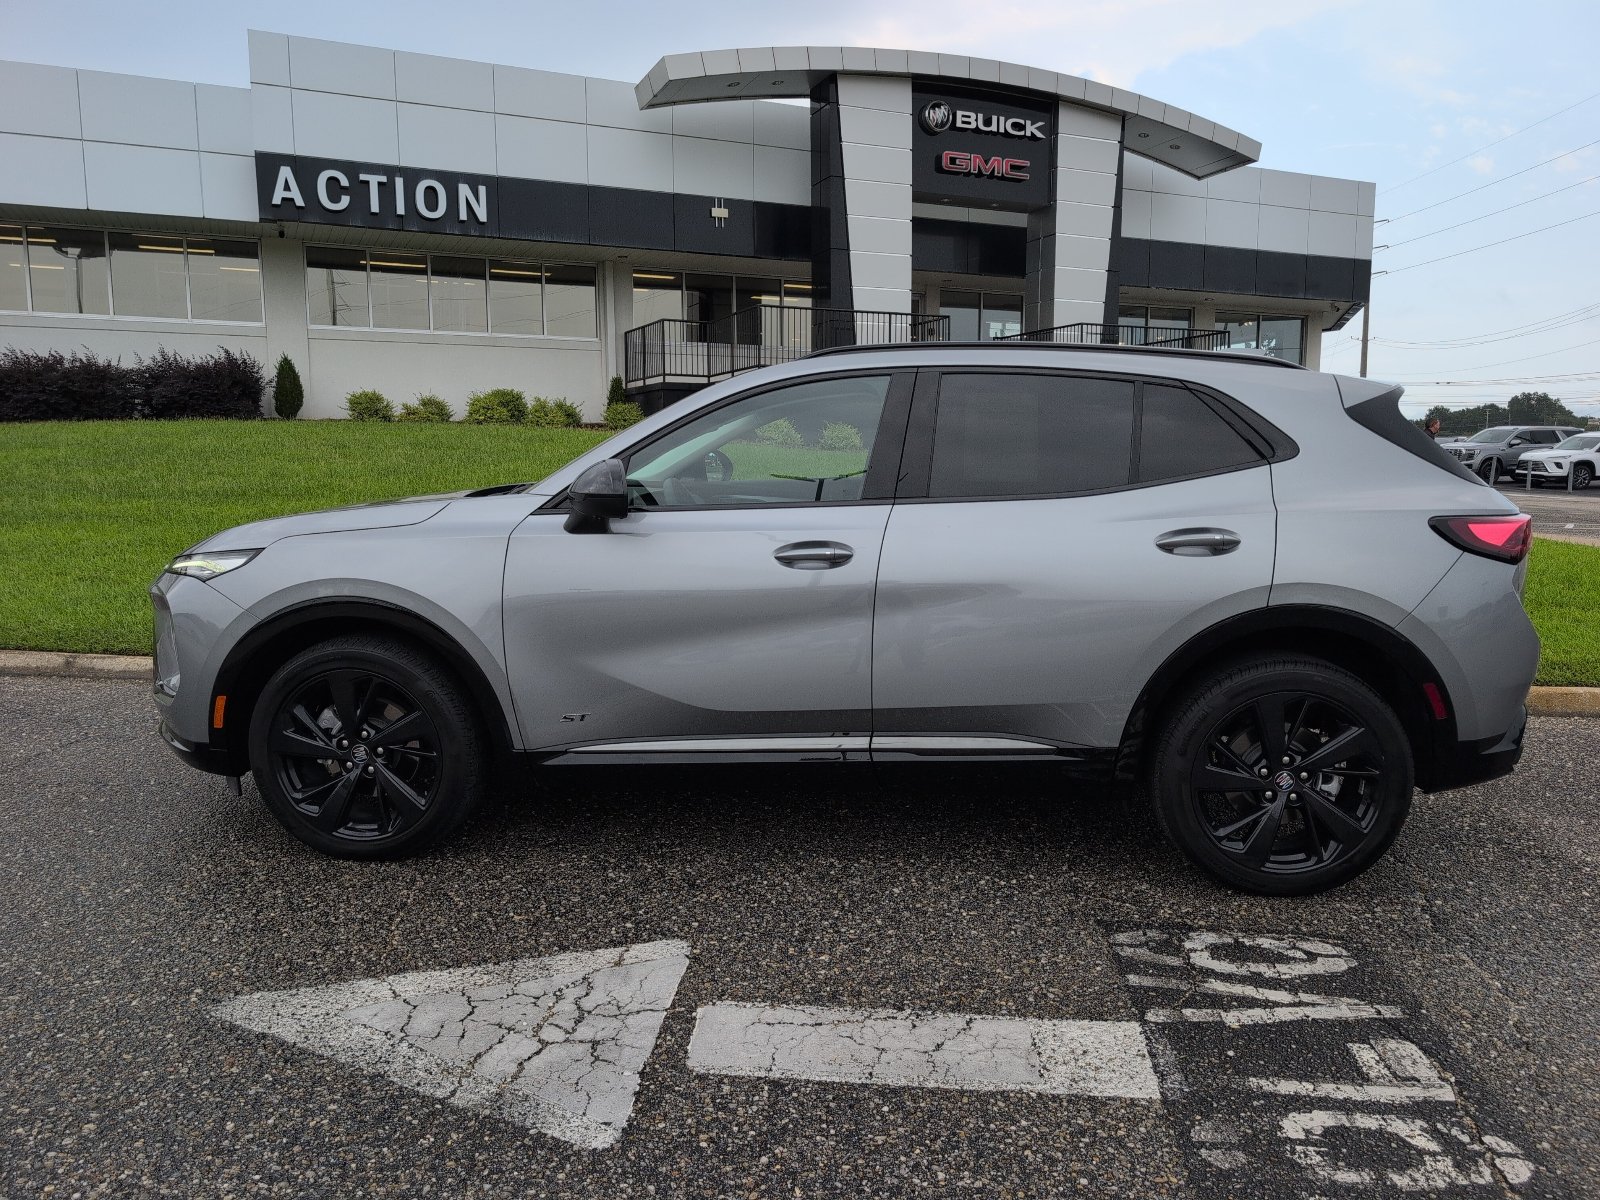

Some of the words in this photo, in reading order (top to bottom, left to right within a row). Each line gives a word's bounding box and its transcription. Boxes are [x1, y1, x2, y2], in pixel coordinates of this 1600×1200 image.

[956, 110, 1046, 139] BUICK
[942, 150, 1030, 180] GMC
[271, 165, 488, 223] ACTION
[560, 712, 592, 723] ST
